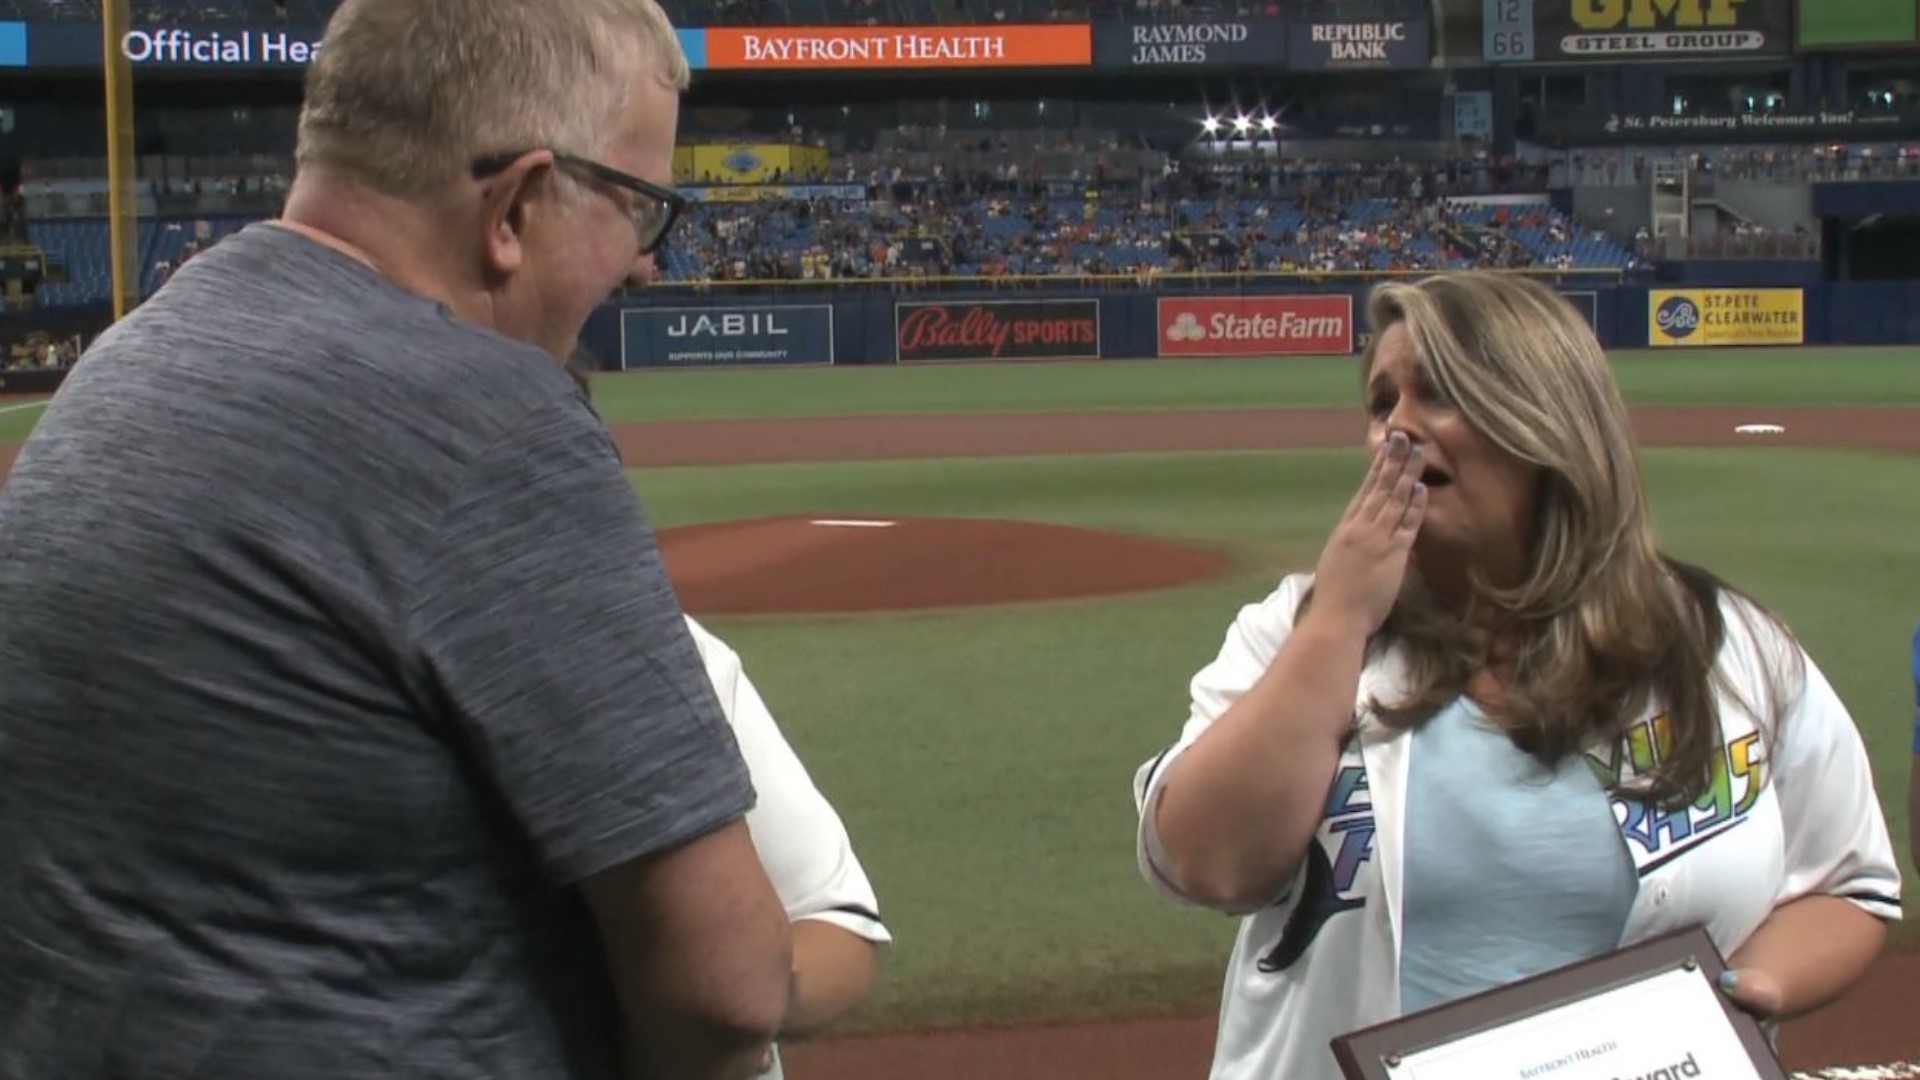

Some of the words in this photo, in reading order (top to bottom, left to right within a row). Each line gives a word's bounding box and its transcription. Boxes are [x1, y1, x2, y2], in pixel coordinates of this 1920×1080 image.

[1132, 23, 1247, 44] RAYMOND
[1311, 22, 1405, 41] REPUBLIC
[121, 29, 249, 61] Official
[742, 34, 889, 60] BAYFRONT
[894, 34, 1004, 59] HEALTH
[1331, 42, 1388, 60] BANK
[1492, 31, 1524, 55] 66
[1575, 36, 1656, 51] STEEL
[1665, 33, 1750, 48] GROUP
[1132, 44, 1207, 64] JAMES
[1649, 113, 1737, 129] Petersburg
[1742, 113, 1815, 126] Welcomes
[667, 313, 789, 337] JABIL
[1704, 311, 1799, 325] CLEARWATER
[899, 304, 1011, 358] Bally
[1013, 319, 1095, 344] SPORTS
